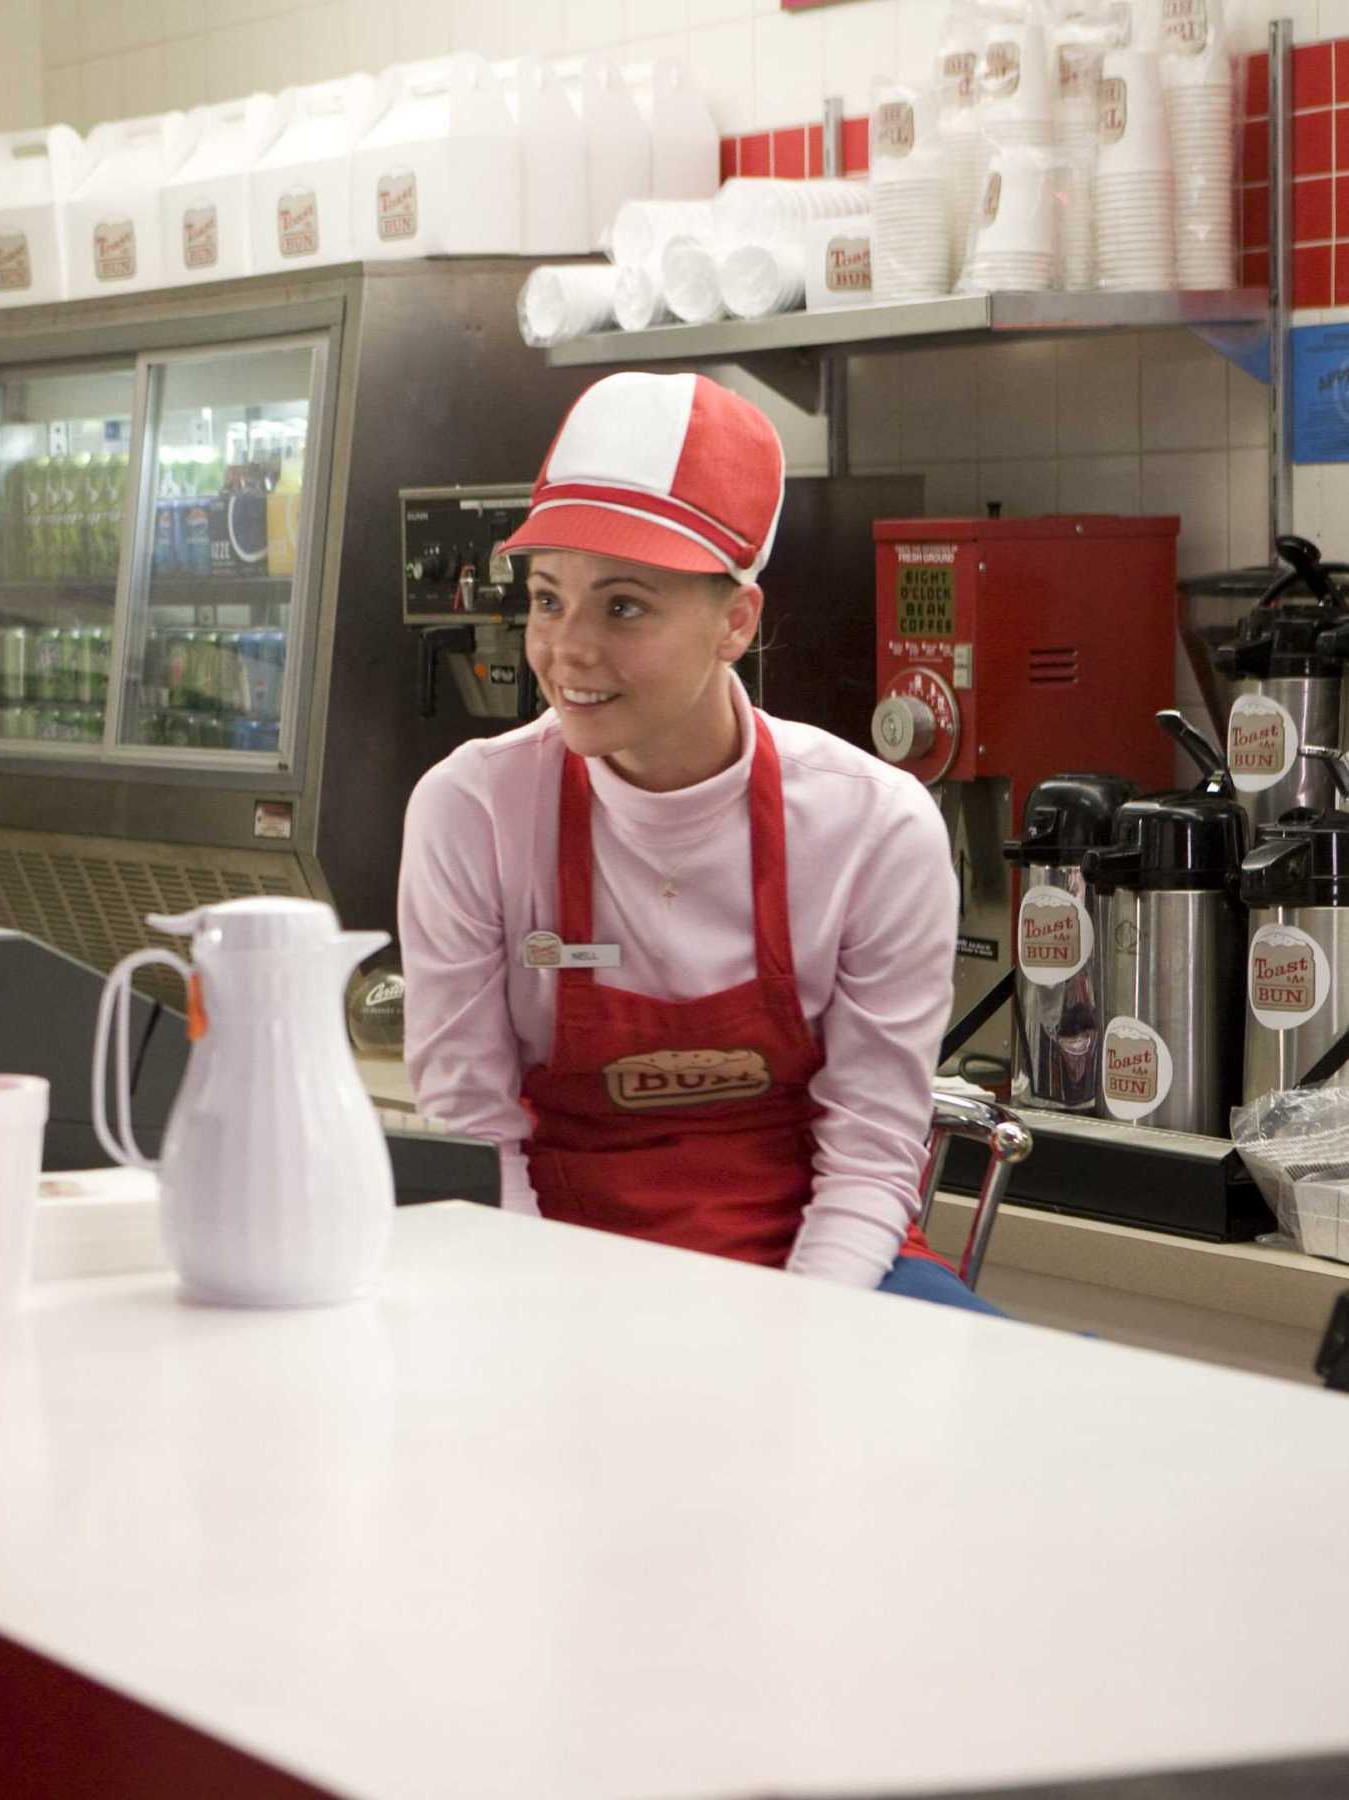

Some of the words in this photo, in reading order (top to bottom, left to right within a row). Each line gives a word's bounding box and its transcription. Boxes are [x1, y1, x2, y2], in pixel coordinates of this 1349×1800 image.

[905, 571, 948, 585] EIGHT
[905, 603, 946, 617] BEAN
[900, 618, 953, 634] COFFEE
[1232, 720, 1279, 747] Toast
[1234, 754, 1275, 767] BUN
[1024, 913, 1074, 938] Toast
[1026, 945, 1068, 960] BUN
[1254, 957, 1308, 980] Toast
[1258, 986, 1303, 1004] BUN
[1107, 1047, 1153, 1070] Toast
[1109, 1078, 1147, 1095] BUN
